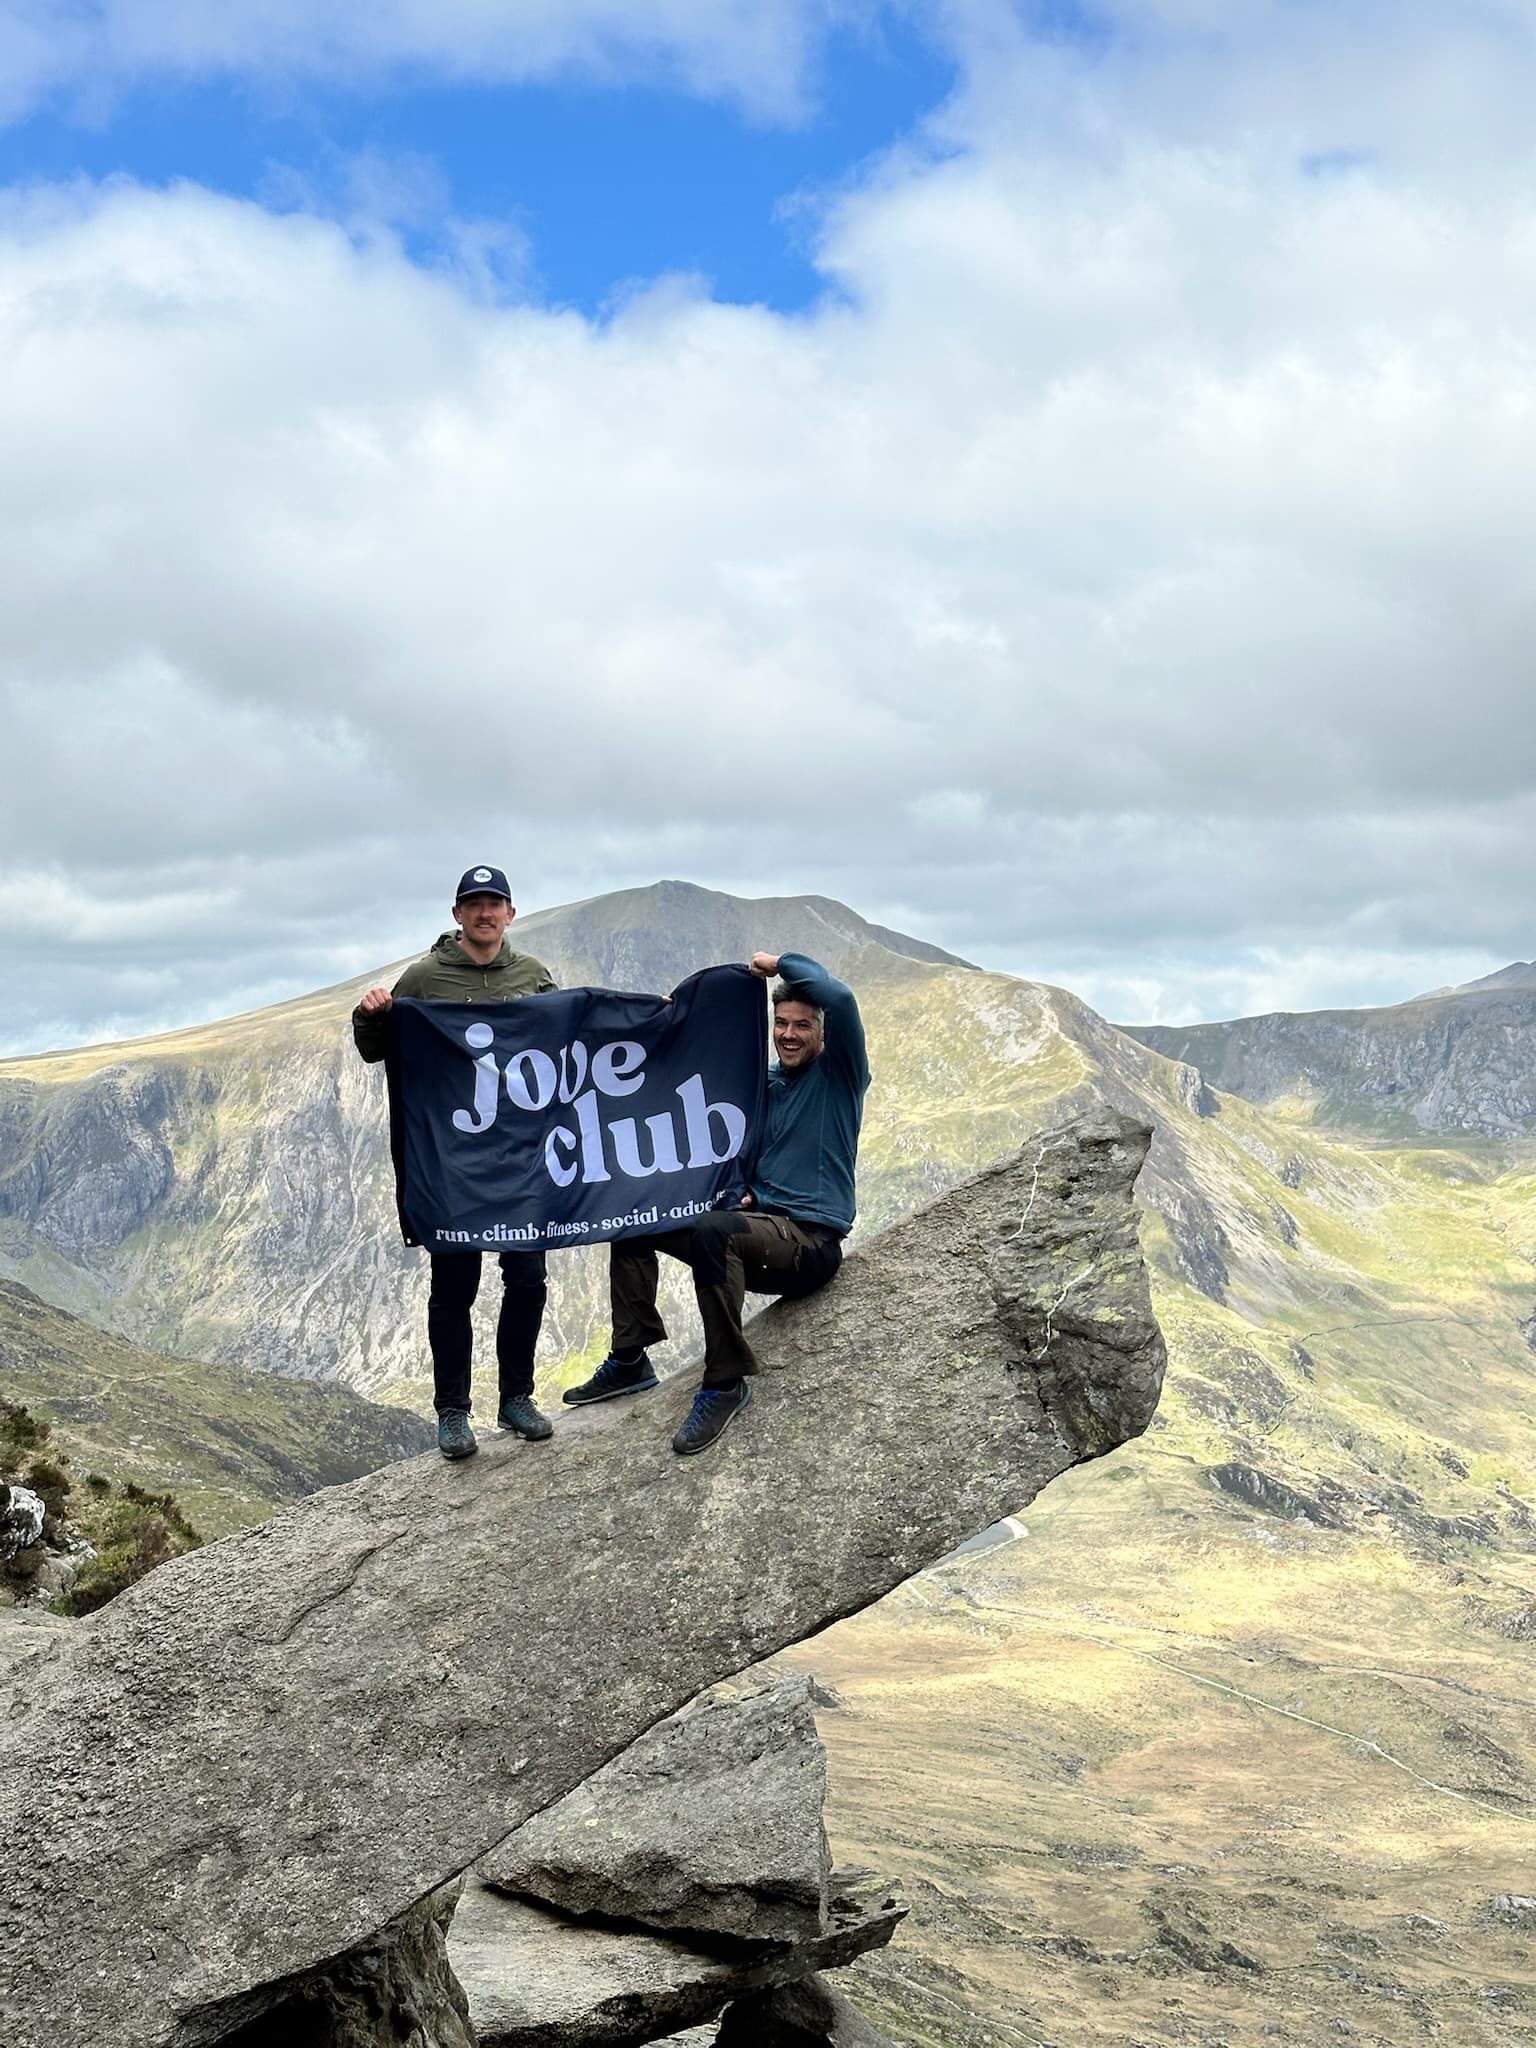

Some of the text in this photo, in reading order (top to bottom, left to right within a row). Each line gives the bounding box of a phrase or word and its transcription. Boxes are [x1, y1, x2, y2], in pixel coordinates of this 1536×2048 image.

[453, 1023, 646, 1133] jove
[545, 1074, 746, 1187] club
[436, 1229, 471, 1242] run
[482, 1222, 539, 1241] climb
[546, 1220, 589, 1239] fitness
[601, 1206, 658, 1230] social
